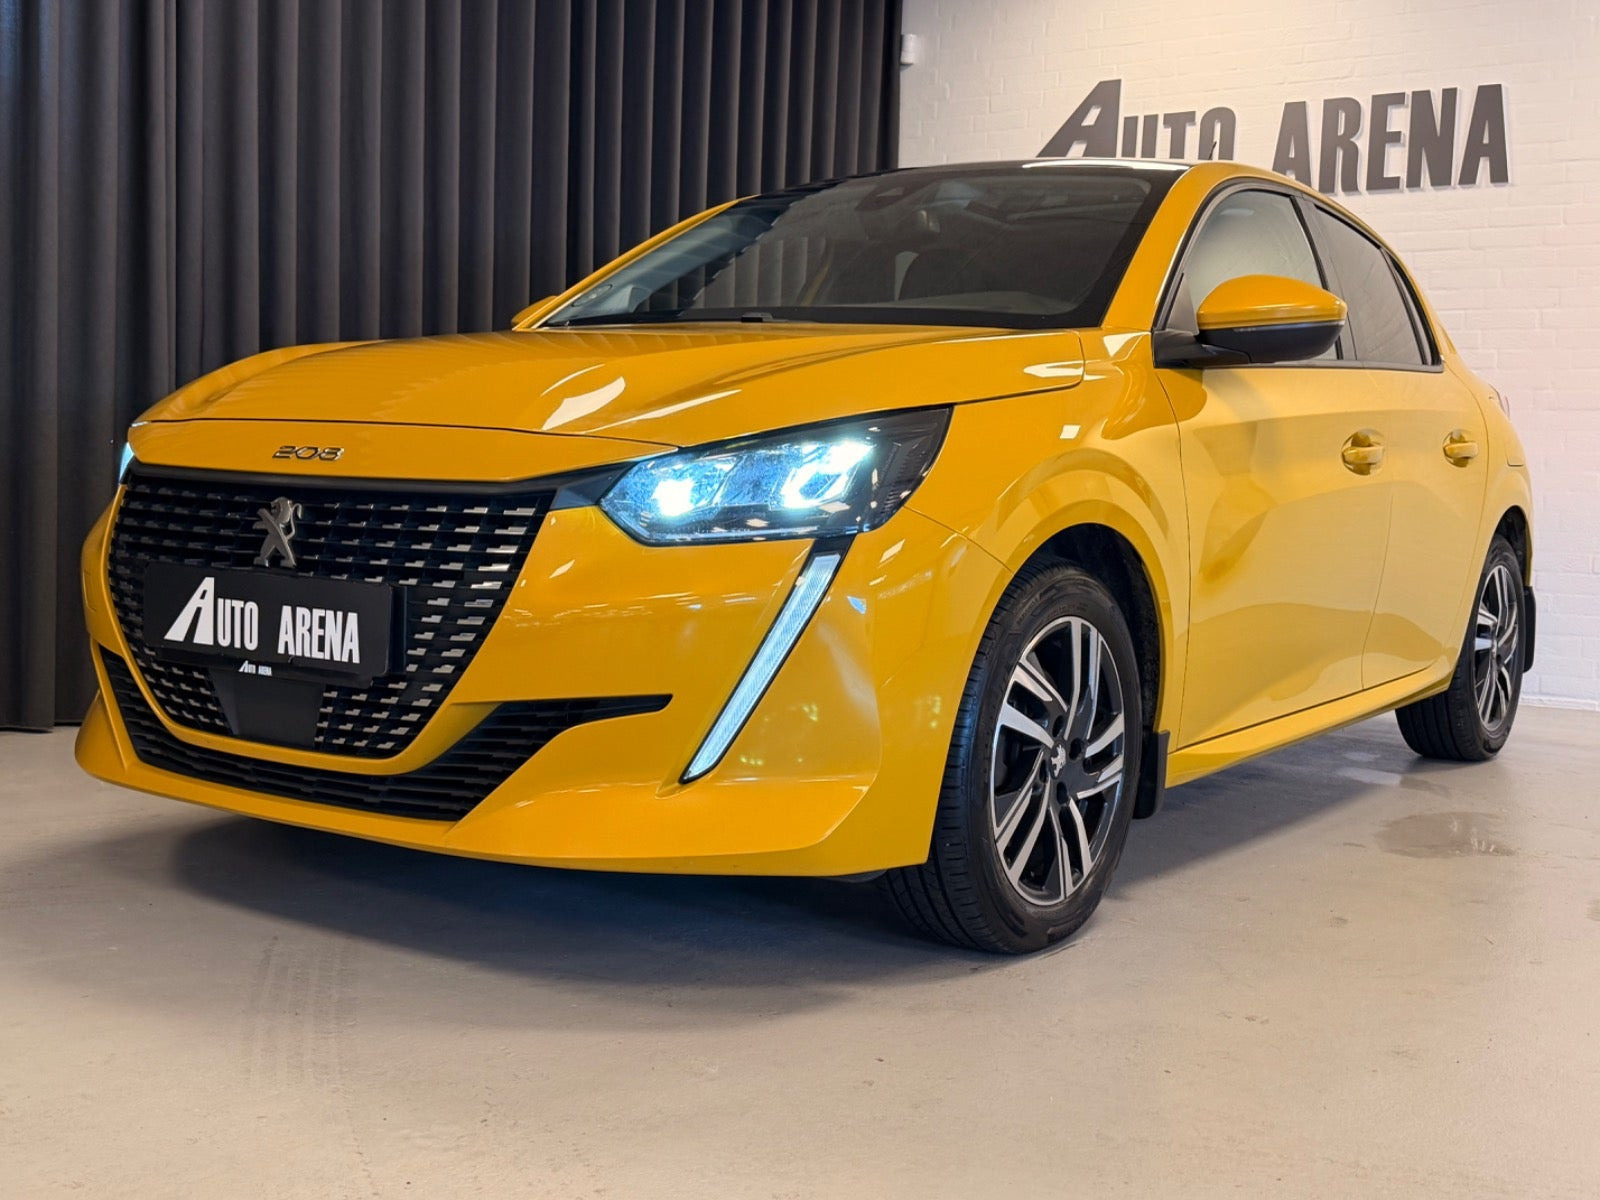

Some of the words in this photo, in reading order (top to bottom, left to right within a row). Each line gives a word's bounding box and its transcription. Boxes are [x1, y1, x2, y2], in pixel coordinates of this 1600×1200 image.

[1272, 83, 1509, 194] ARENA
[272, 445, 344, 461] 208
[164, 577, 259, 651] AUTO
[277, 605, 360, 664] ARENA
